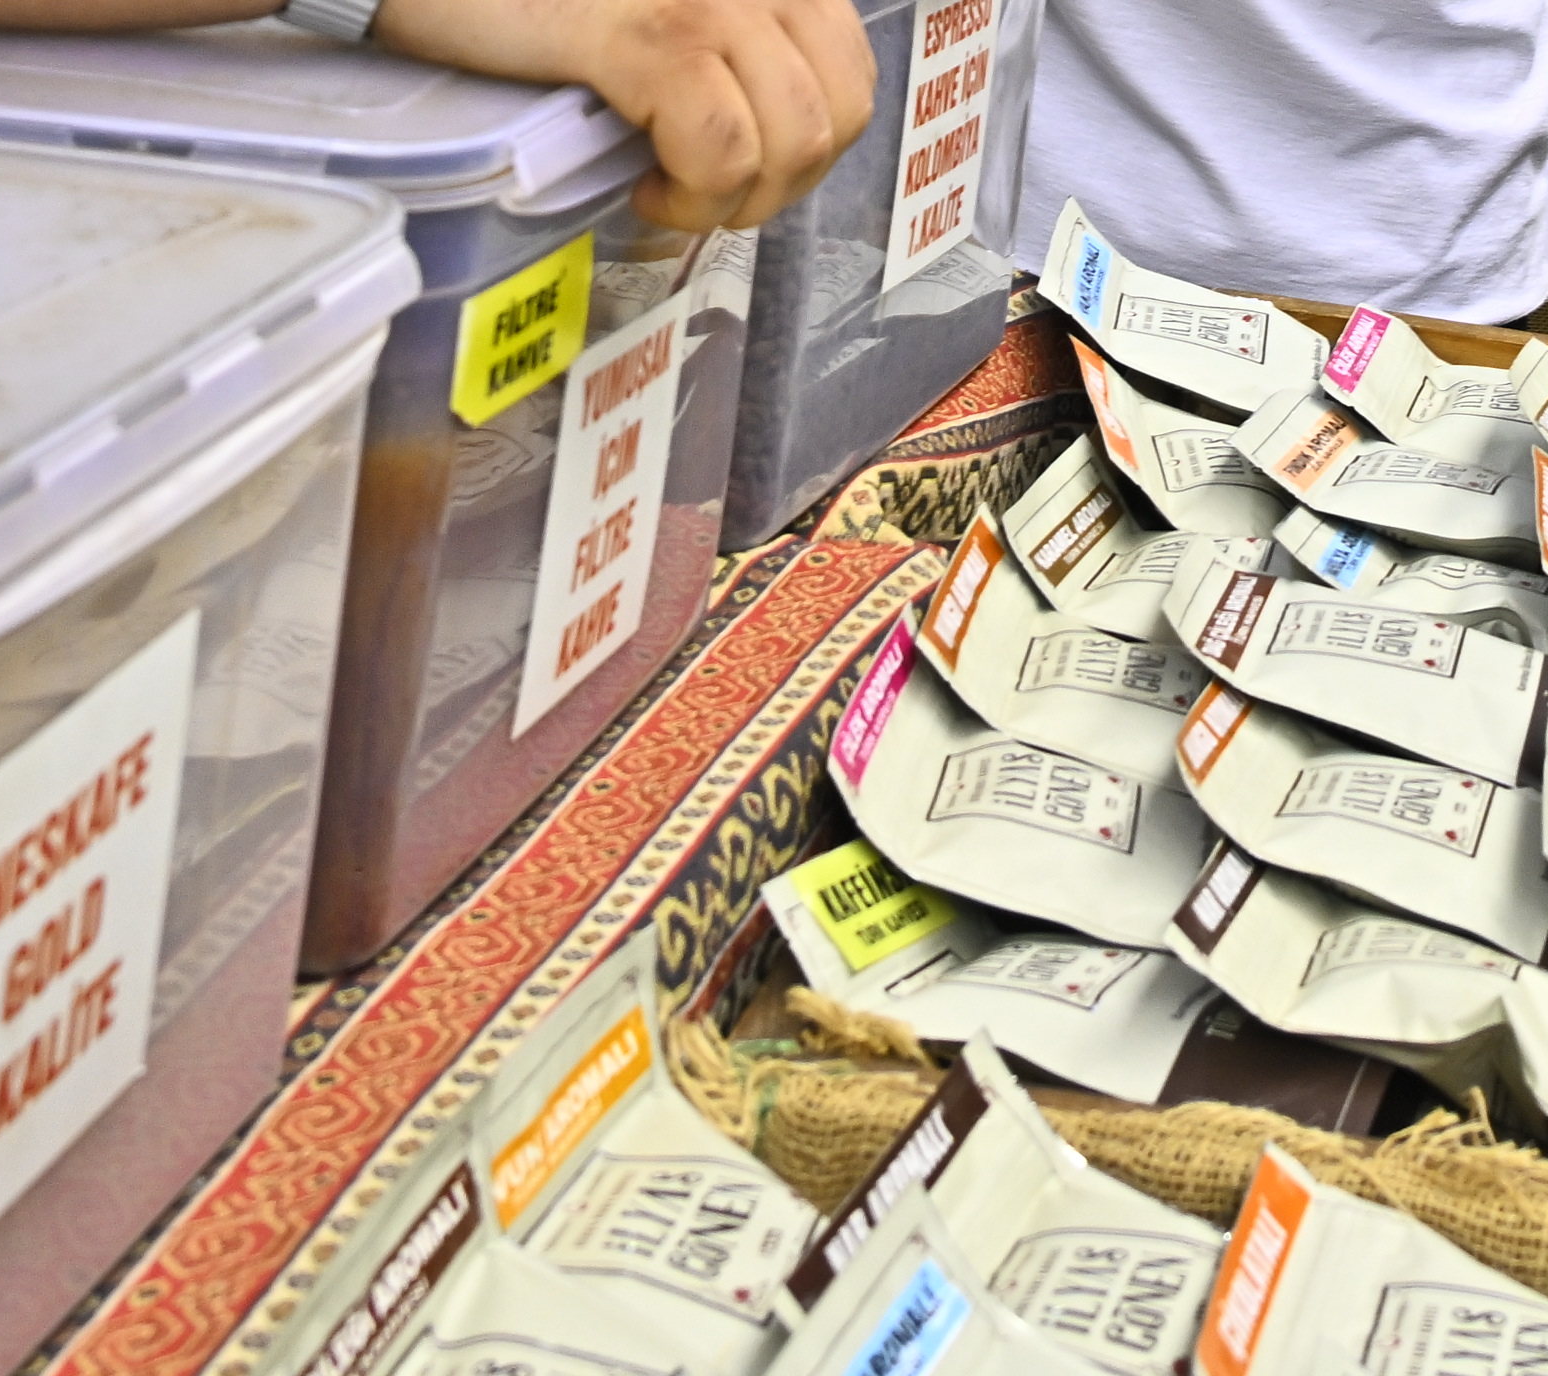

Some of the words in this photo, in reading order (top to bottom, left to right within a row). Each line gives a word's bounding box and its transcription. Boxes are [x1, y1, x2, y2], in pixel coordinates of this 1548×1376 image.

[913, 65, 959, 129] KAHVE
[961, 43, 990, 104] İÇİN
[903, 113, 981, 199] KOLOMBİYA
[907, 183, 966, 258] 1.KALİTE
[492, 278, 561, 346] FİLTRE
[487, 329, 556, 397] KAHVE
[571, 495, 638, 593] FİLTRE
[555, 580, 624, 678] KAHVE
[1, 876, 106, 1025] GOLD
